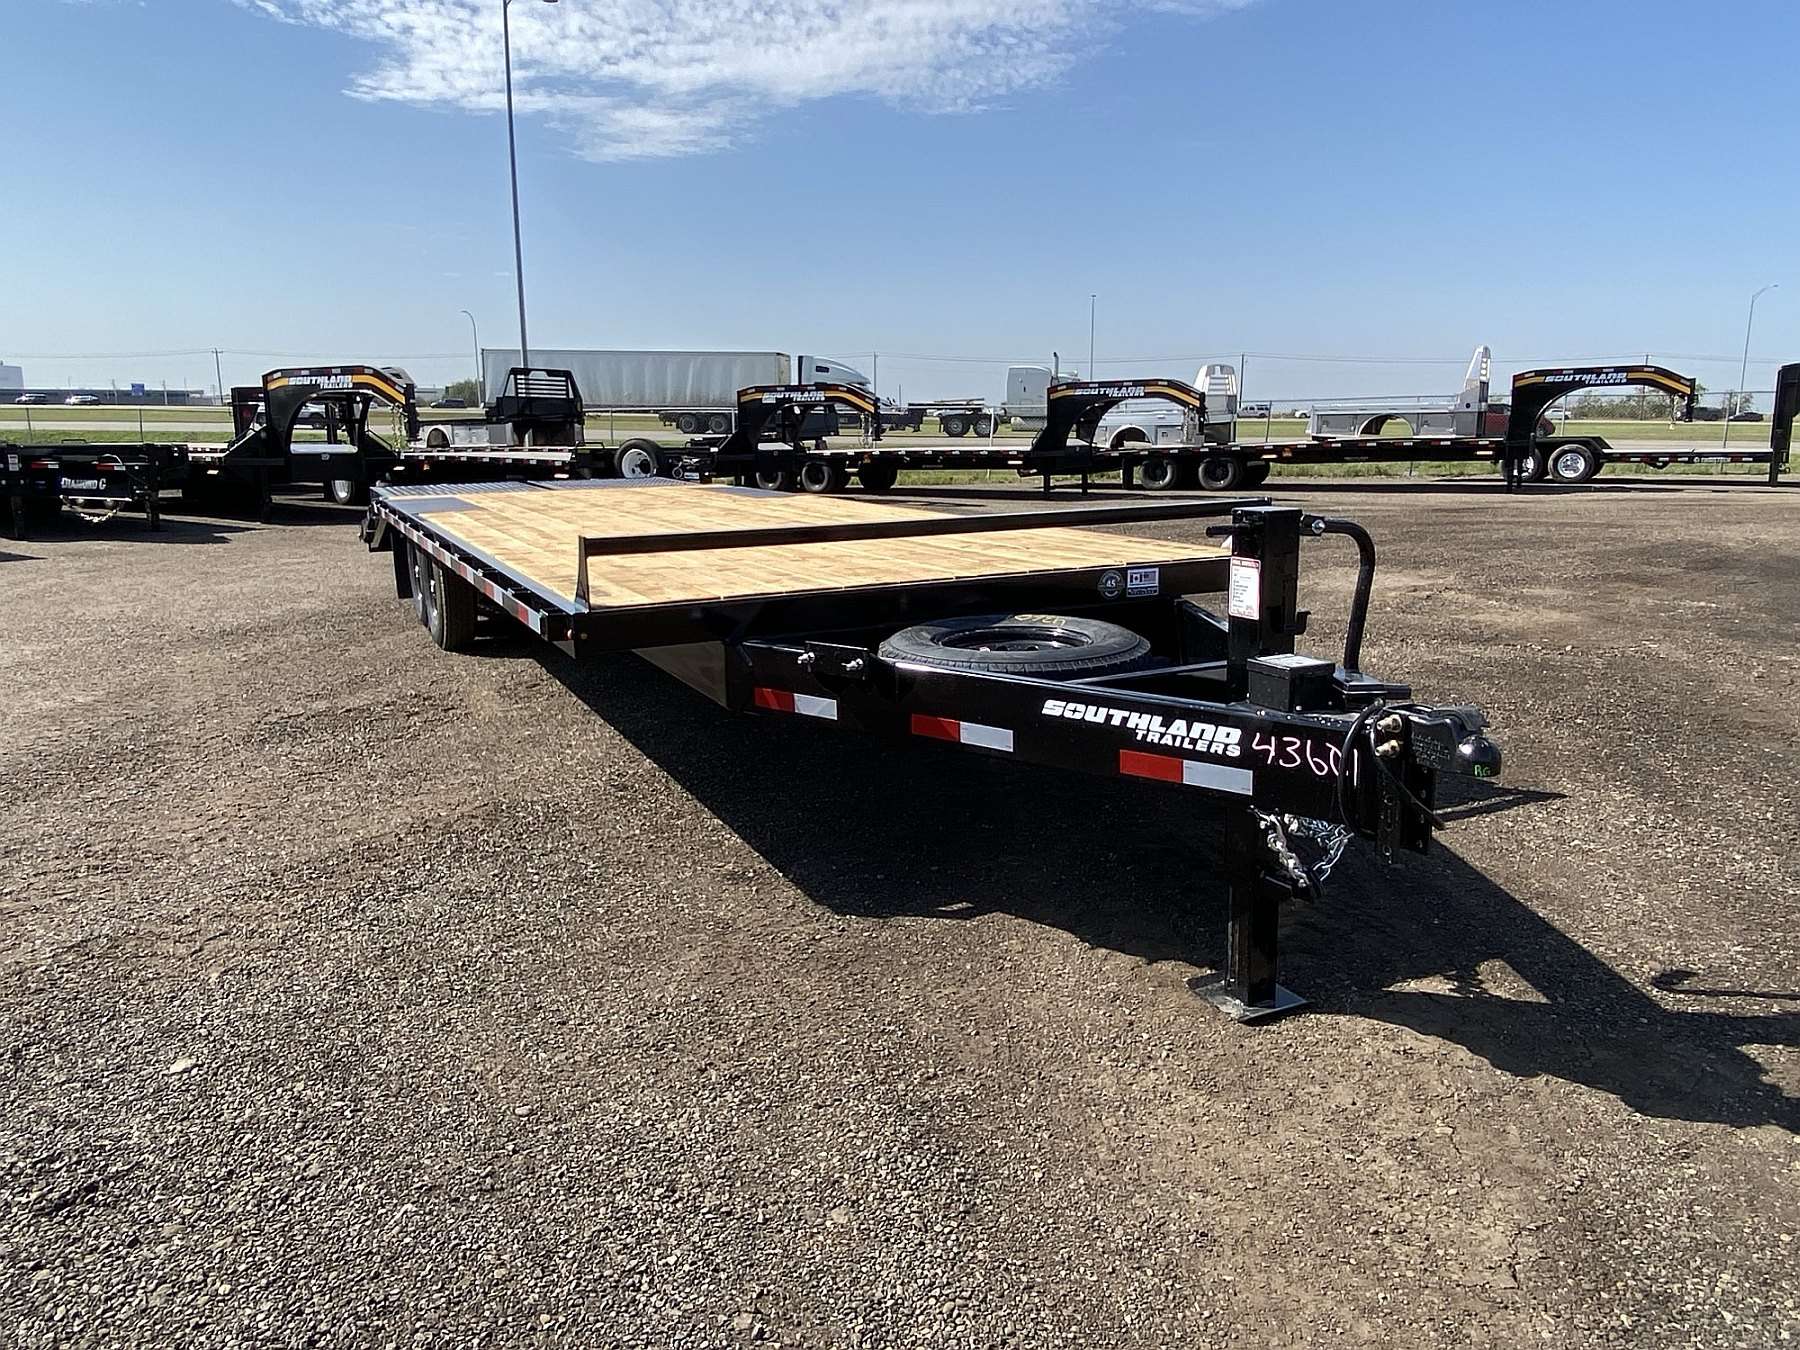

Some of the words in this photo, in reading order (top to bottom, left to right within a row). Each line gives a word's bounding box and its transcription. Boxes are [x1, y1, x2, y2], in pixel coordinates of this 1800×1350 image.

[288, 375, 353, 386] SOUTHLAND
[1545, 372, 1628, 383] SOUTHLAND
[1041, 699, 1242, 745] SOUTHLAND
[1135, 729, 1241, 757] TRAILERS
